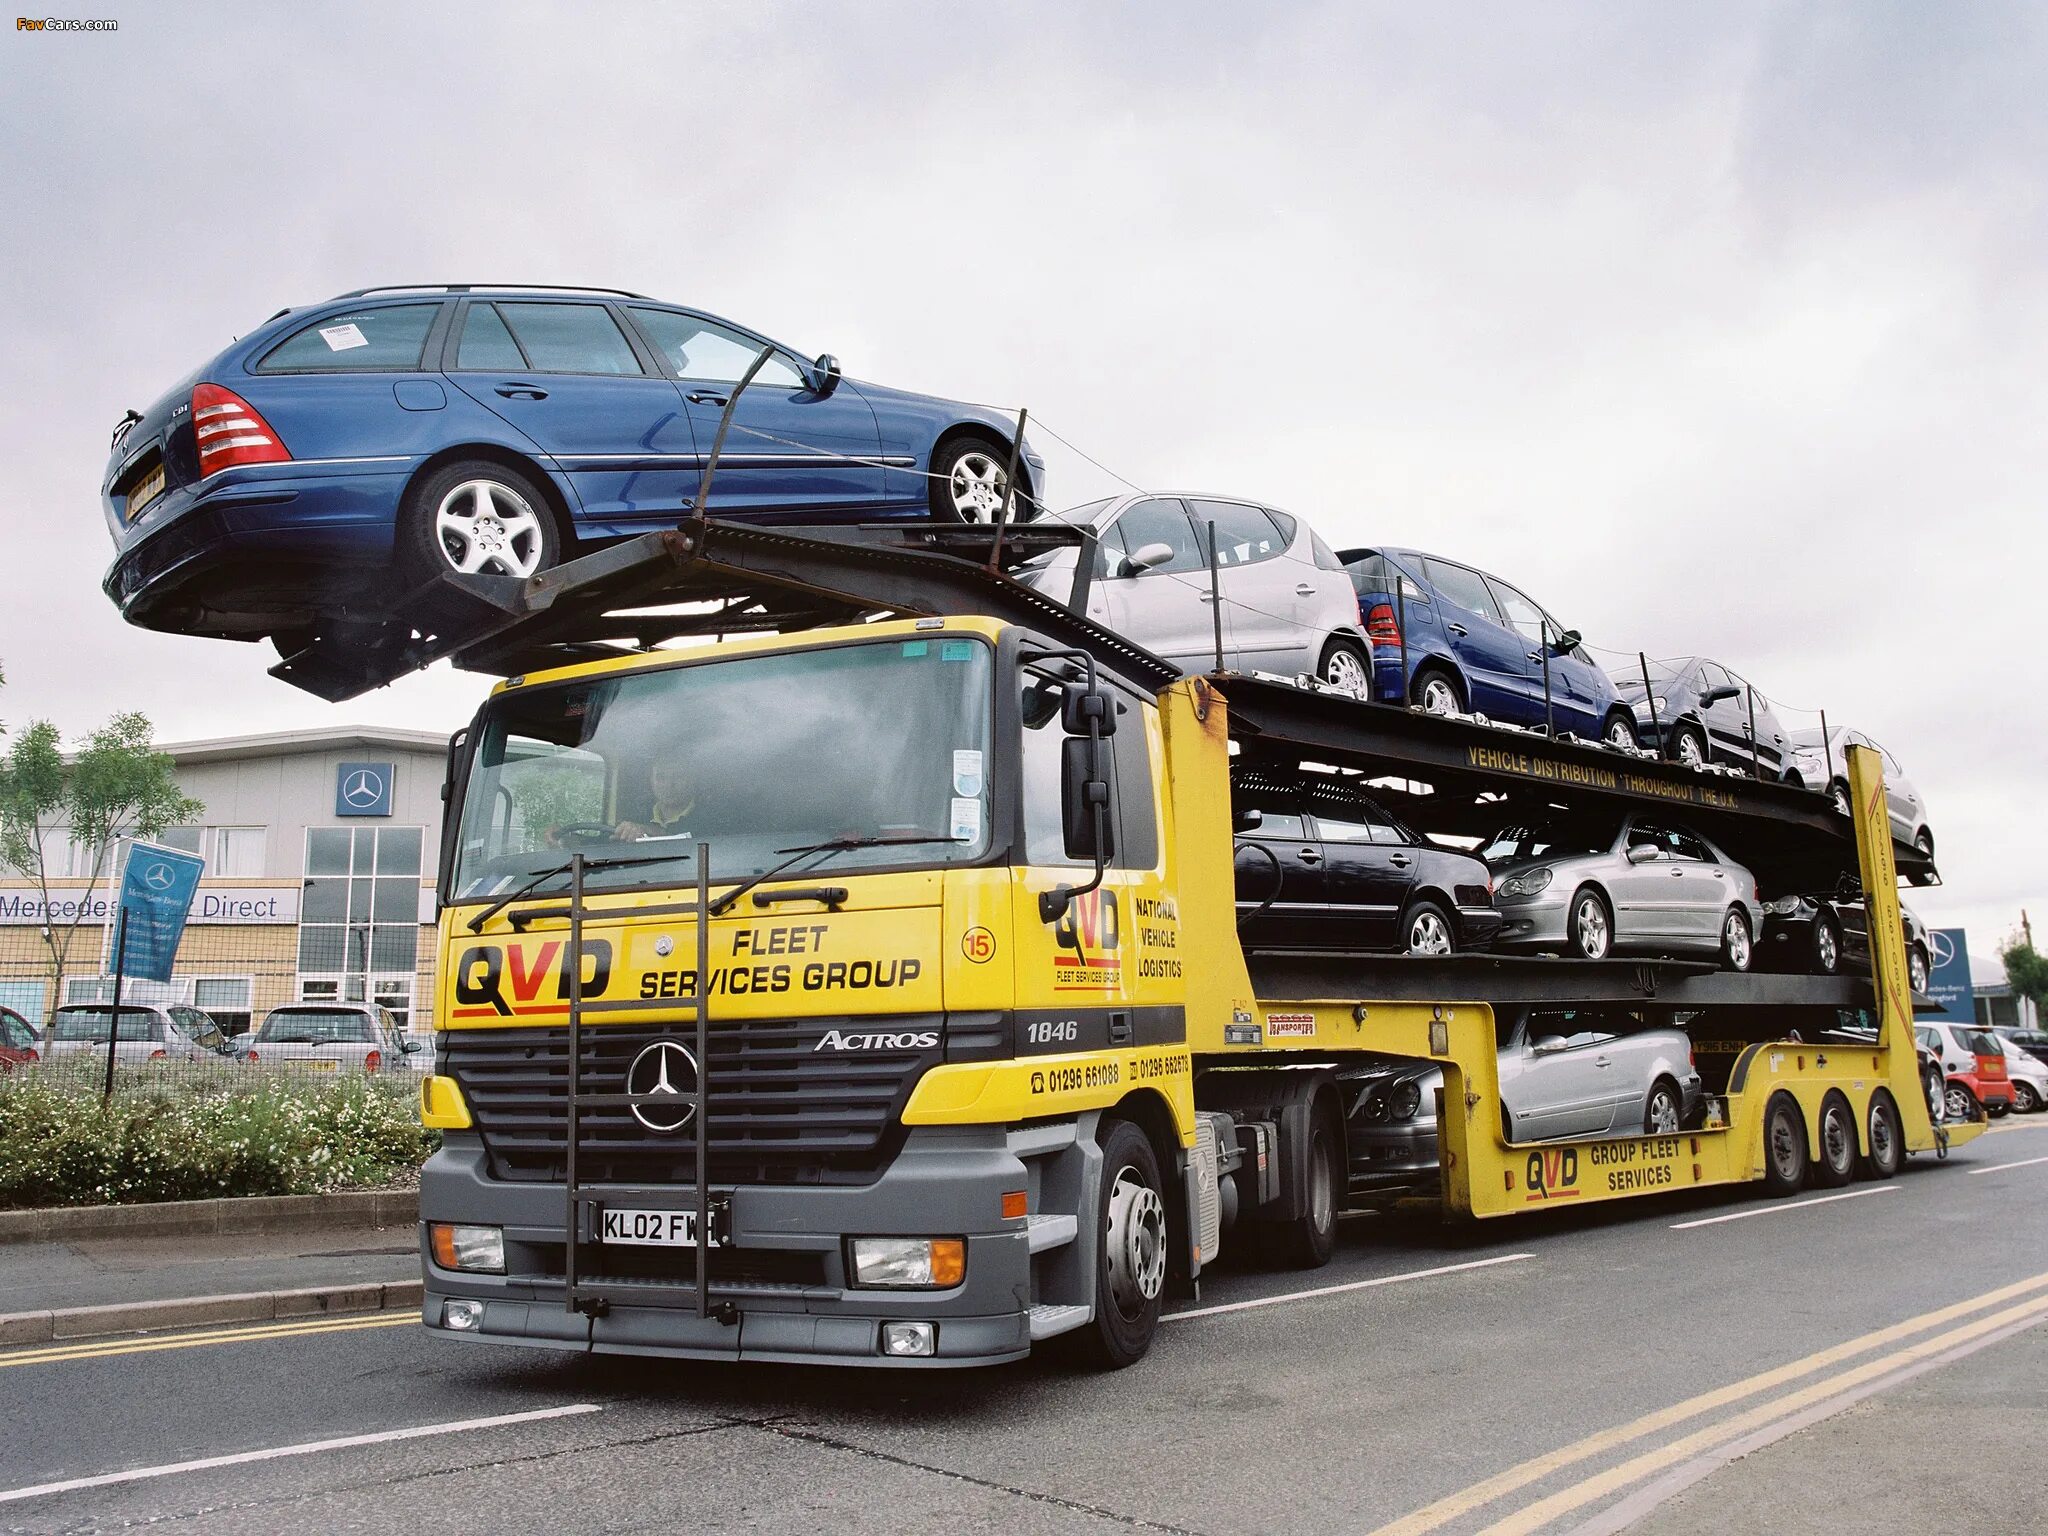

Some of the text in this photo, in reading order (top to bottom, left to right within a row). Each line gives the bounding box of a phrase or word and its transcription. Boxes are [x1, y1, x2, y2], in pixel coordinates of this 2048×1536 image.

[1468, 746, 1528, 773] VEHICLE
[1533, 758, 1616, 788] DISTRIBUTION
[1623, 773, 1694, 801] THROUGHOUT
[1701, 787, 1718, 804] THE
[203, 895, 276, 918] Direct
[1136, 897, 1176, 921] NATIONAL
[732, 925, 828, 957] FLEET
[965, 934, 990, 957] 15
[1141, 928, 1176, 948] VEHICLE
[456, 939, 613, 1016] QVD
[639, 958, 921, 999] SERVICES GROUP
[1056, 970, 1074, 982] FLEET
[1075, 971, 1102, 983] SERVICES
[1138, 959, 1182, 978] LOGISTICS
[1028, 1021, 1078, 1043] 1846
[1049, 1071, 1082, 1092] 01296
[1085, 1063, 1119, 1087] 661088
[1140, 1059, 1163, 1078] 01296
[1591, 1139, 1680, 1166] GROUP FLEET
[1526, 1149, 1578, 1199] QVD
[1608, 1165, 1672, 1191] SERVICES
[604, 1212, 662, 1240] KL02
